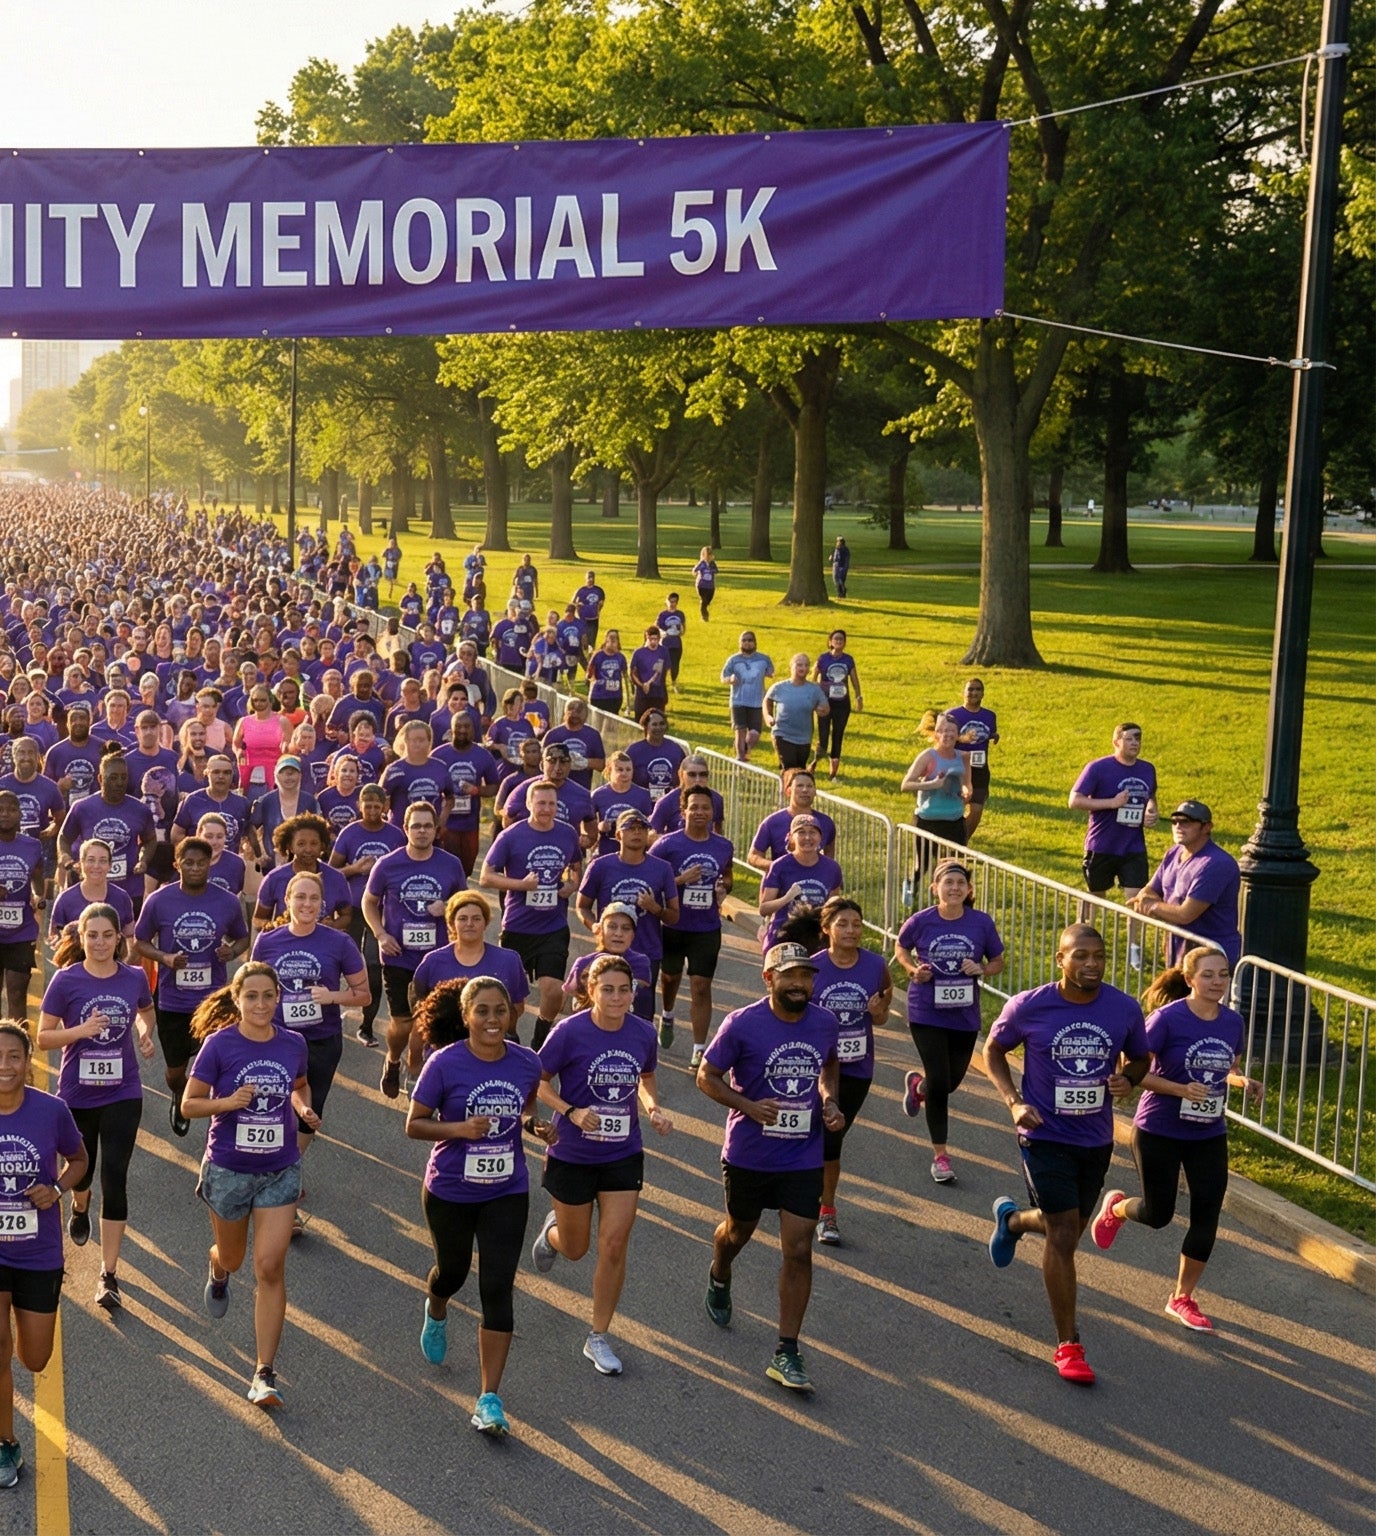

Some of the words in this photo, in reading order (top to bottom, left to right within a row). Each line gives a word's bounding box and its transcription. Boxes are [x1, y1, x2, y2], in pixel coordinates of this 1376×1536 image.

[183, 193, 645, 288] MEMORIAL
[669, 187, 778, 276] 5K
[89, 1061, 114, 1075] 181
